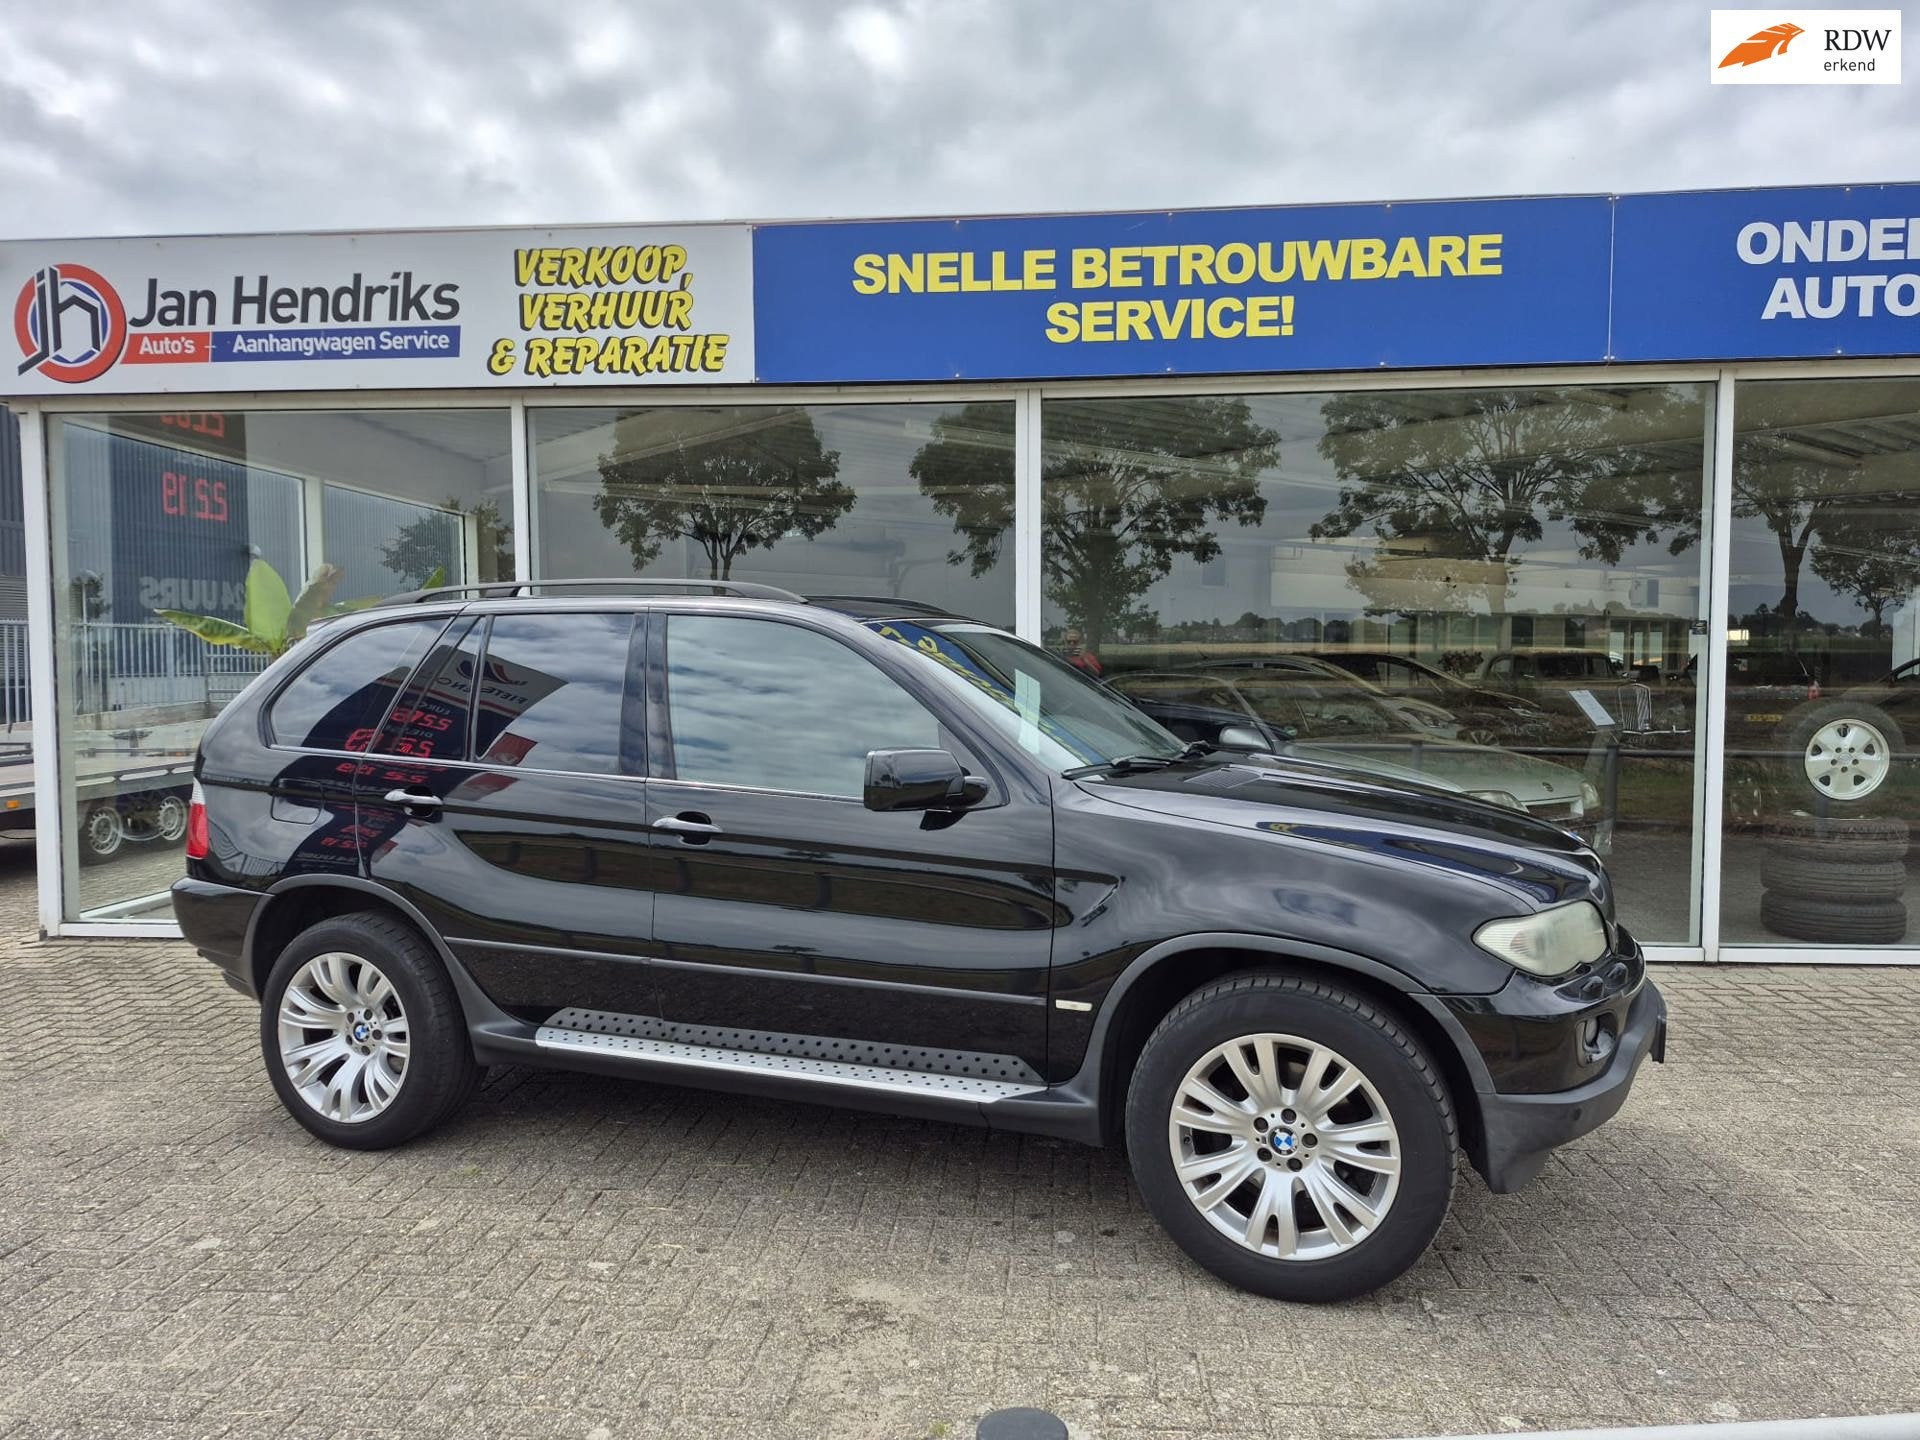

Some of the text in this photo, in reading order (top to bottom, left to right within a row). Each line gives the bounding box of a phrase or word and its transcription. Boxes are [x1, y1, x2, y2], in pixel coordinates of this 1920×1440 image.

[515, 245, 693, 290] VERKOOP,
[852, 233, 1503, 294] SNELLE BETROUWBARE
[128, 271, 461, 328] Jan Hendriks
[519, 290, 694, 332] VERHUUR
[1045, 295, 1295, 343] SERVICE!
[1760, 274, 1920, 320] AUTO
[139, 336, 195, 355] Auto's
[232, 333, 376, 356] Aanhangwagen
[379, 329, 450, 350] Service
[487, 334, 729, 378] & REPARATIE
